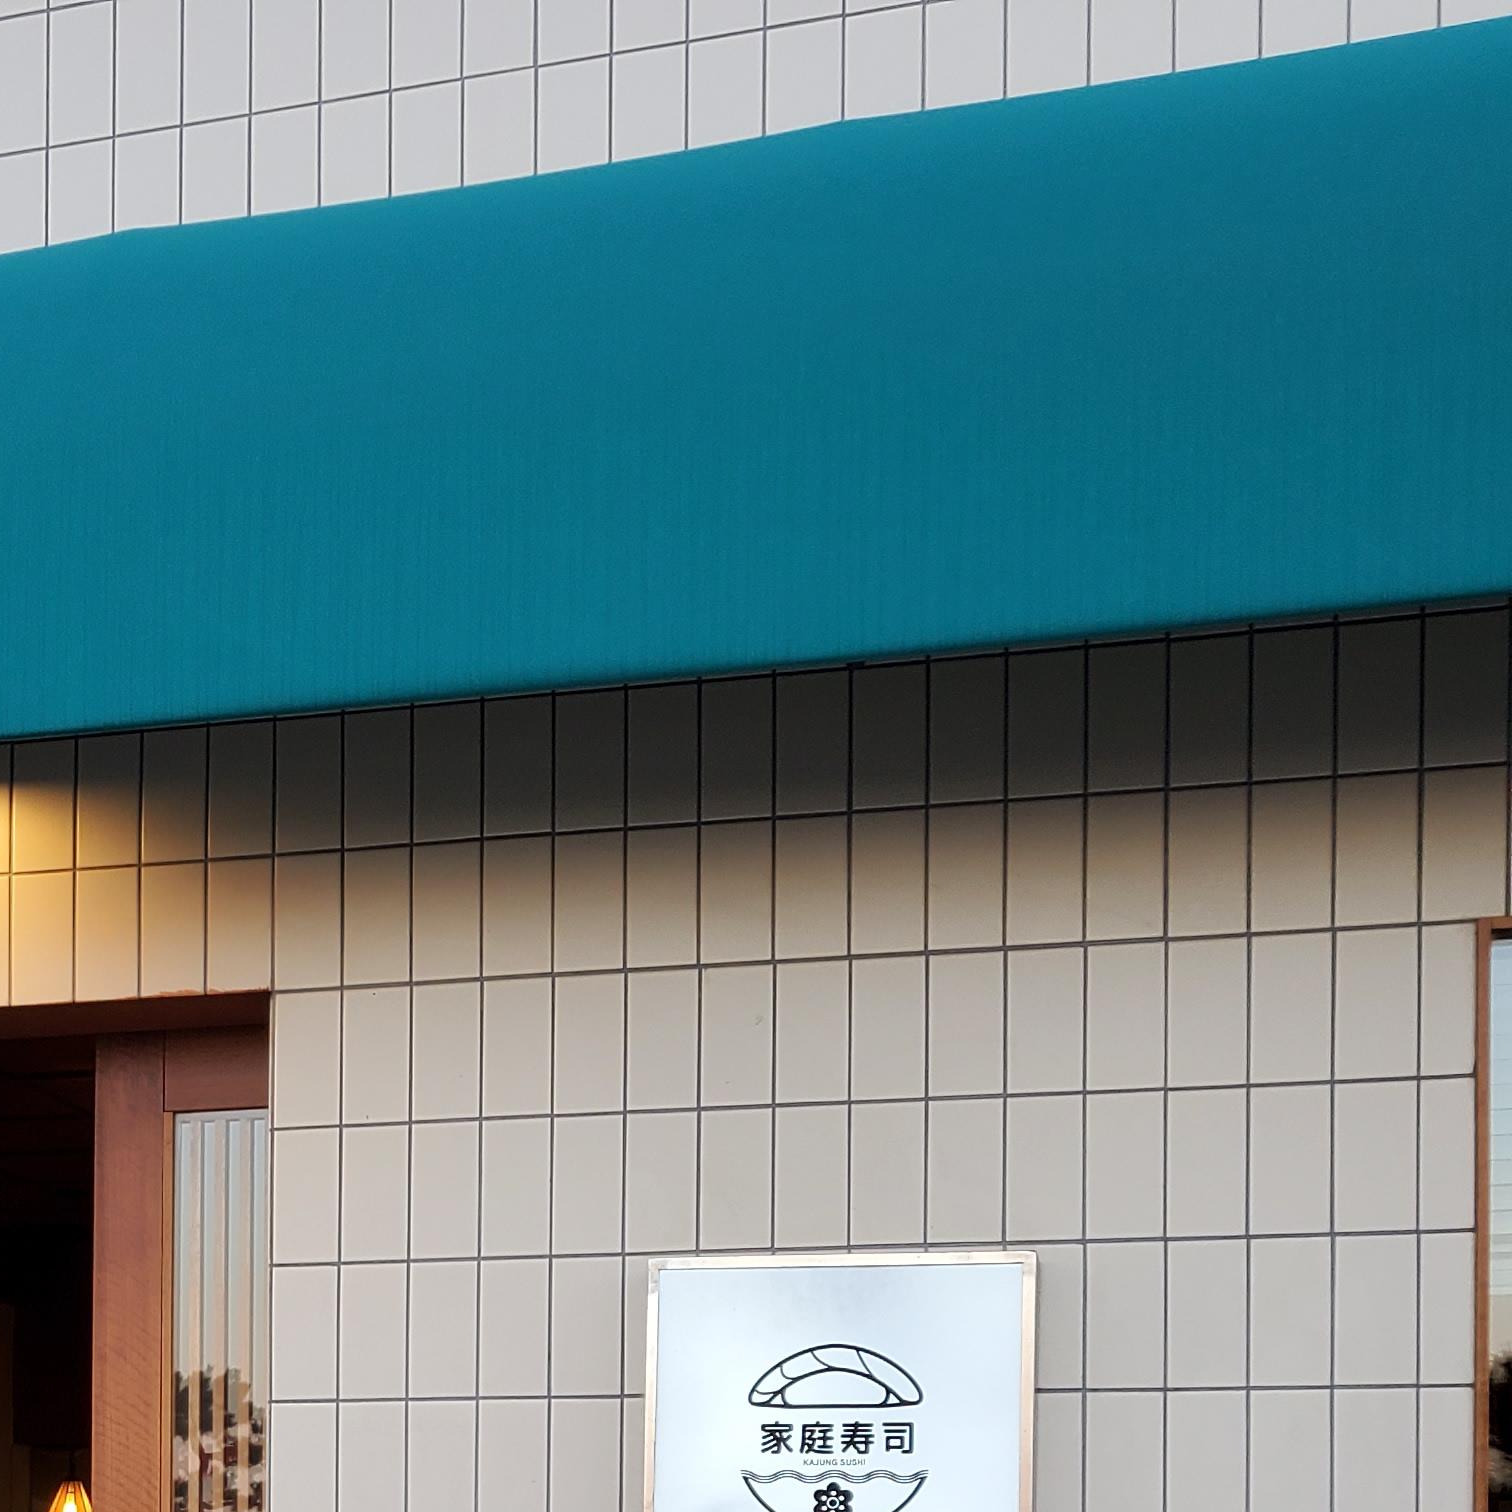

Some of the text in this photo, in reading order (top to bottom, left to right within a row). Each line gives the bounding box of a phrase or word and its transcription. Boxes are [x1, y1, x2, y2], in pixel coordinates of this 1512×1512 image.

[760, 1420, 915, 1455] 家庭寿司
[802, 1458, 866, 1466] KAJUNG SUSHI
